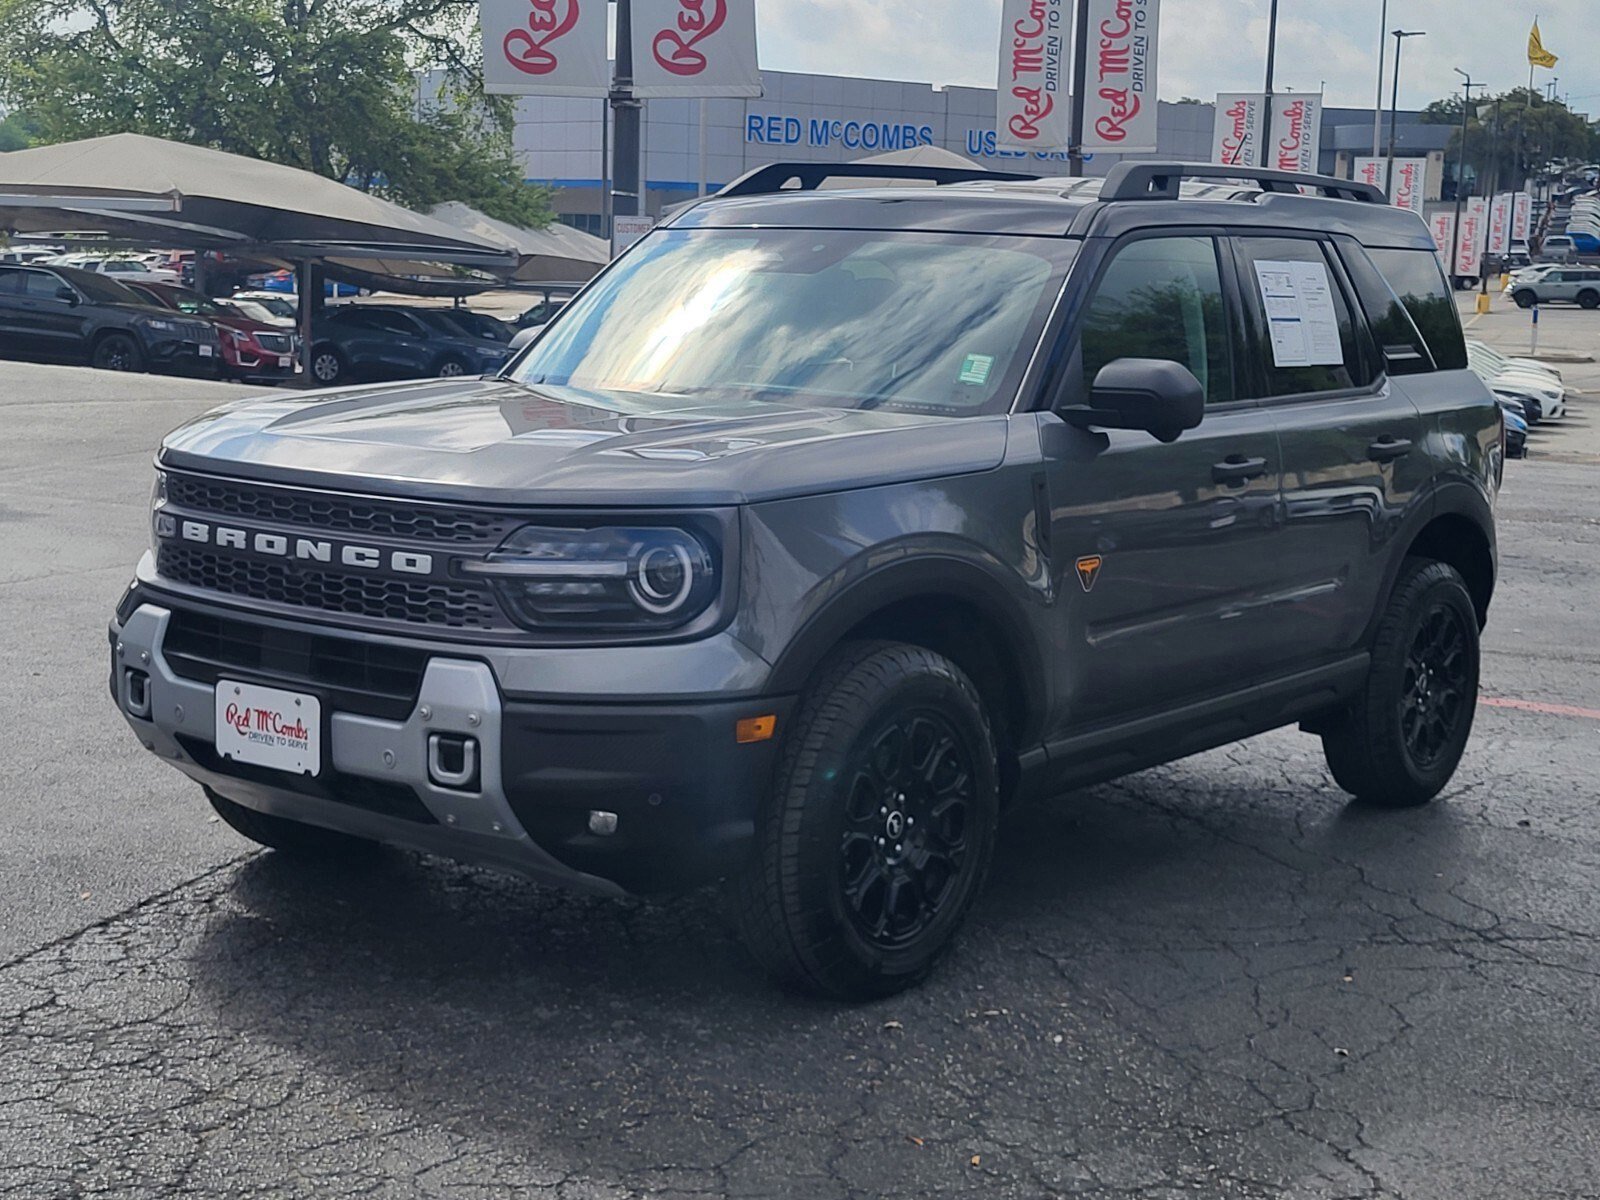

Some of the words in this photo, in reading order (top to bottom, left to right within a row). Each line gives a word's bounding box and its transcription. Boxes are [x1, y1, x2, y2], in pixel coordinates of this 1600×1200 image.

[1048, 10, 1060, 30] TO
[1134, 10, 1147, 30] TO
[1045, 36, 1059, 91] DRIVEN
[1132, 36, 1145, 92] DRIVEN
[1008, 86, 1053, 139] Red
[1095, 87, 1140, 141] Red
[1246, 100, 1256, 130] SERVE
[1303, 100, 1313, 130] SERVE
[748, 115, 801, 144] RED
[1302, 132, 1311, 145] TO
[182, 520, 432, 575] BRONCO
[226, 703, 250, 736] Red
[253, 708, 309, 740] McCombs
[248, 731, 274, 745] DRIVEN
[276, 736, 287, 746] TO
[288, 739, 309, 752] SERVE
